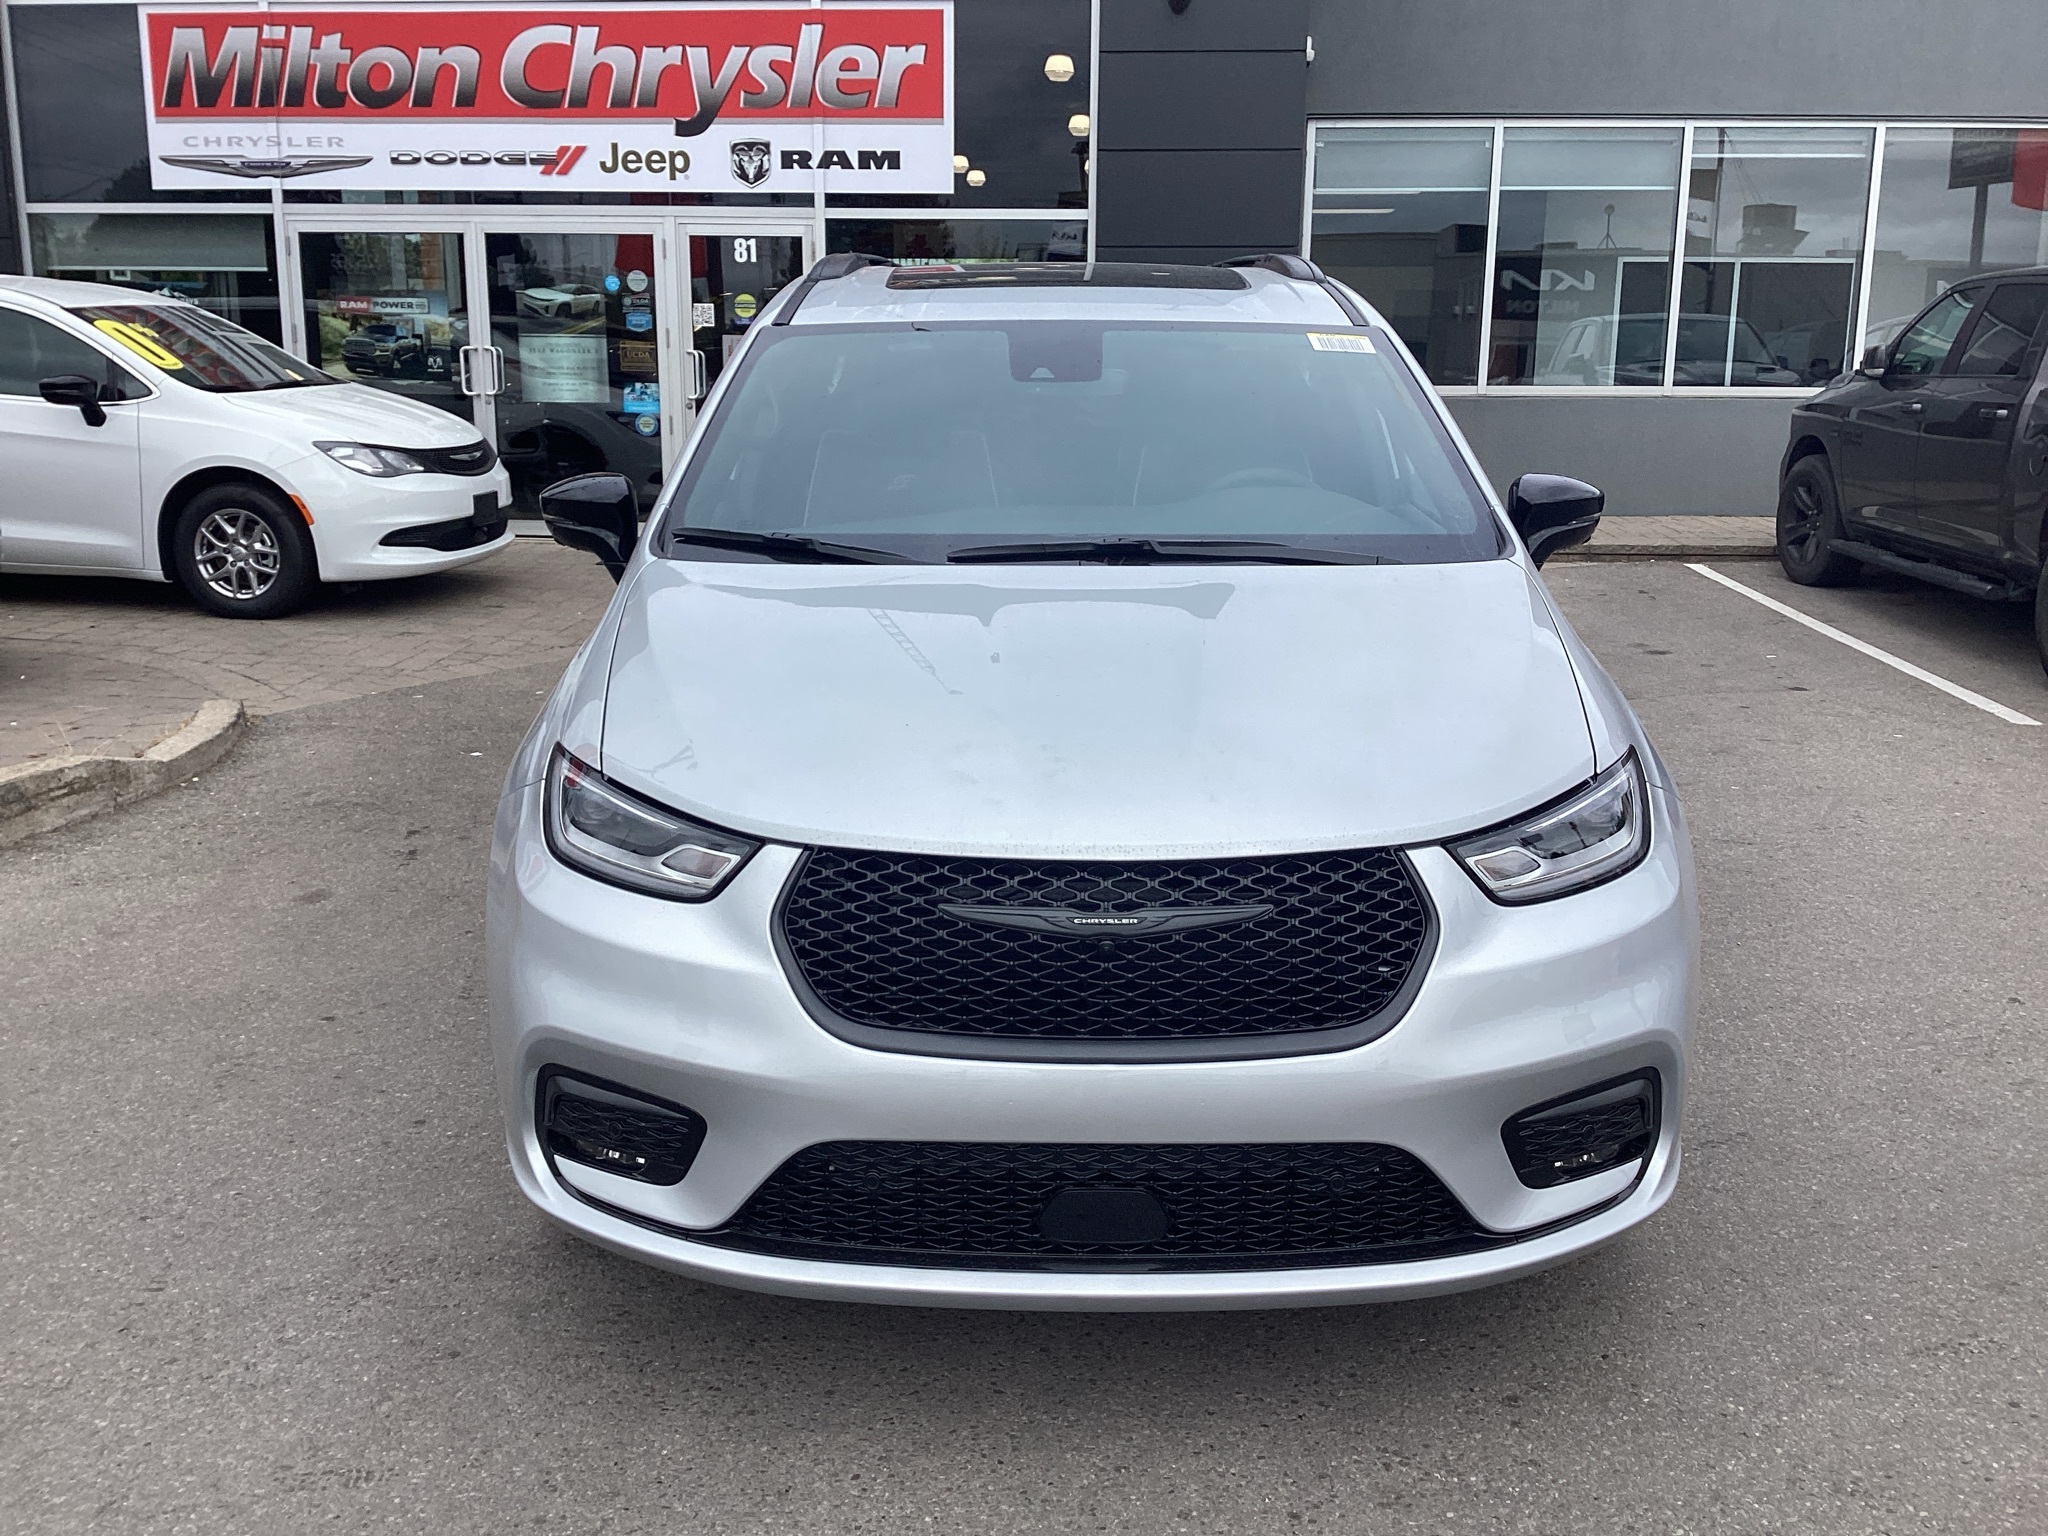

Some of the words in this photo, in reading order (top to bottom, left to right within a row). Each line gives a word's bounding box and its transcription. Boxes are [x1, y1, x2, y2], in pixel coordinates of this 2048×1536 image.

[161, 24, 481, 108] Milton
[500, 22, 927, 137] Chrysler
[183, 136, 344, 148] CHRYSLER
[389, 149, 559, 166] DODGE
[599, 142, 690, 181] Jeep
[780, 149, 901, 170] RAM
[734, 238, 757, 263] 81
[339, 300, 368, 309] RAM
[372, 301, 414, 309] POWER
[626, 351, 651, 359] UCDA
